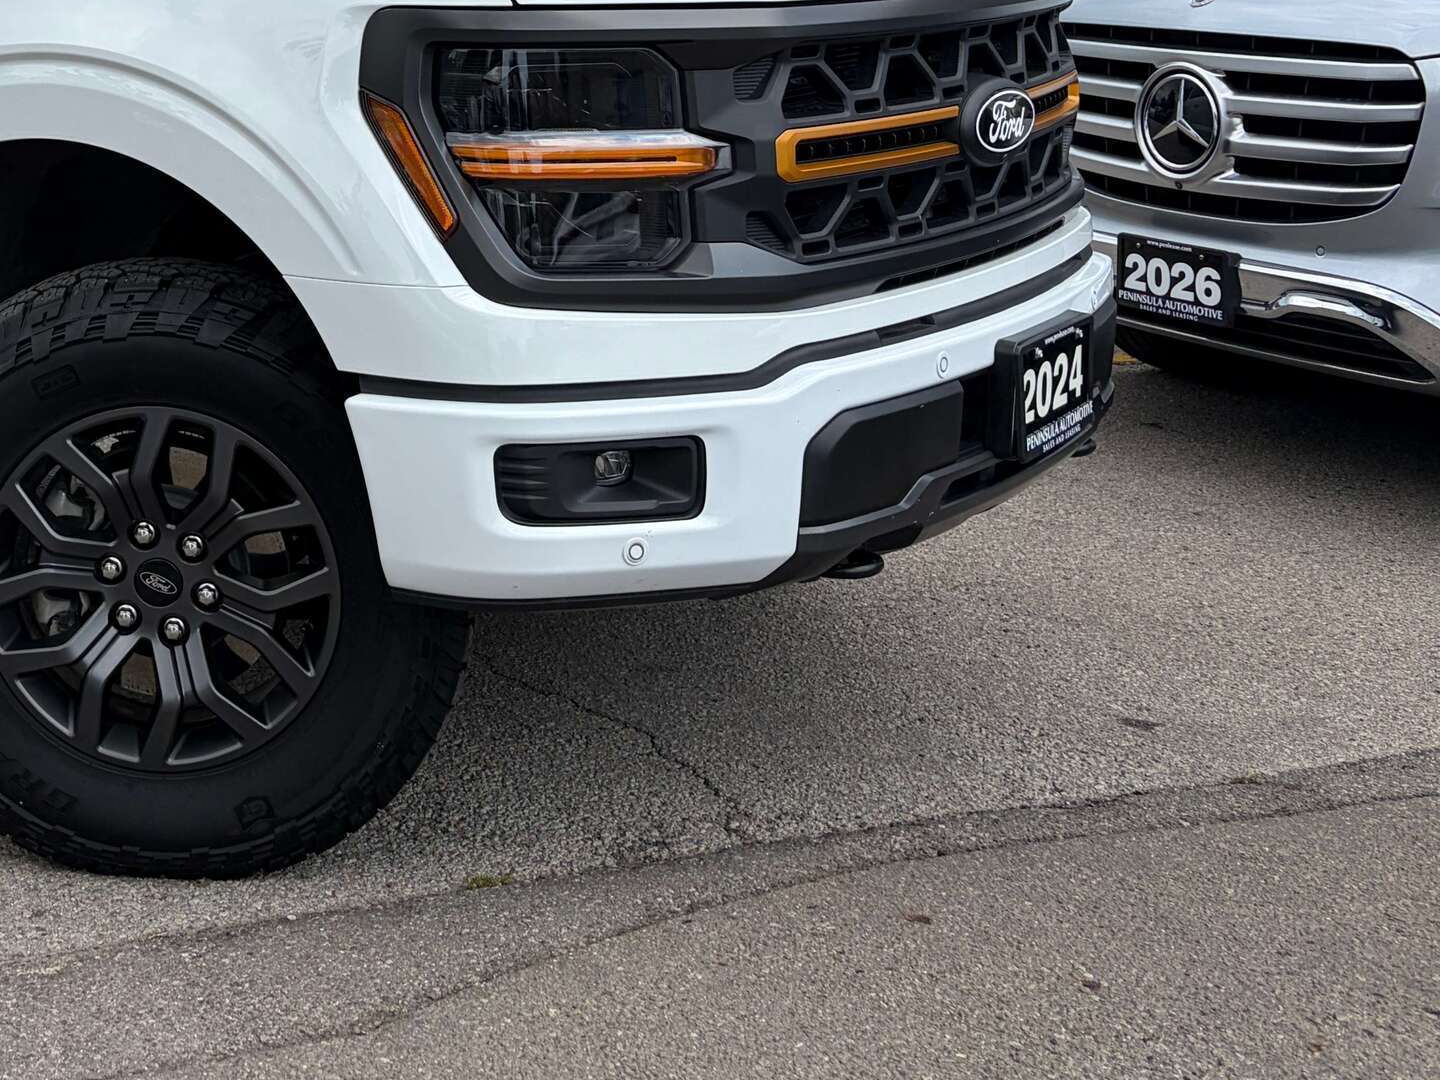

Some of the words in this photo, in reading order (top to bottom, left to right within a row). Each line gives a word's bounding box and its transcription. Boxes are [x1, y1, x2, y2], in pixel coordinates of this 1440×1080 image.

[988, 99, 1026, 144] Ford
[1124, 253, 1222, 307] 2026
[1118, 289, 1163, 308] PENINSULA
[1164, 300, 1223, 321] AUTOMOTIVE
[1139, 304, 1157, 313] SALES
[1158, 308, 1171, 316] AND
[1172, 311, 1199, 322] LEASING
[1023, 344, 1084, 425] 2024
[1026, 420, 1060, 452] PENINSULA
[1059, 400, 1094, 432] AUTOMOTIVE
[145, 575, 172, 592] Ford
